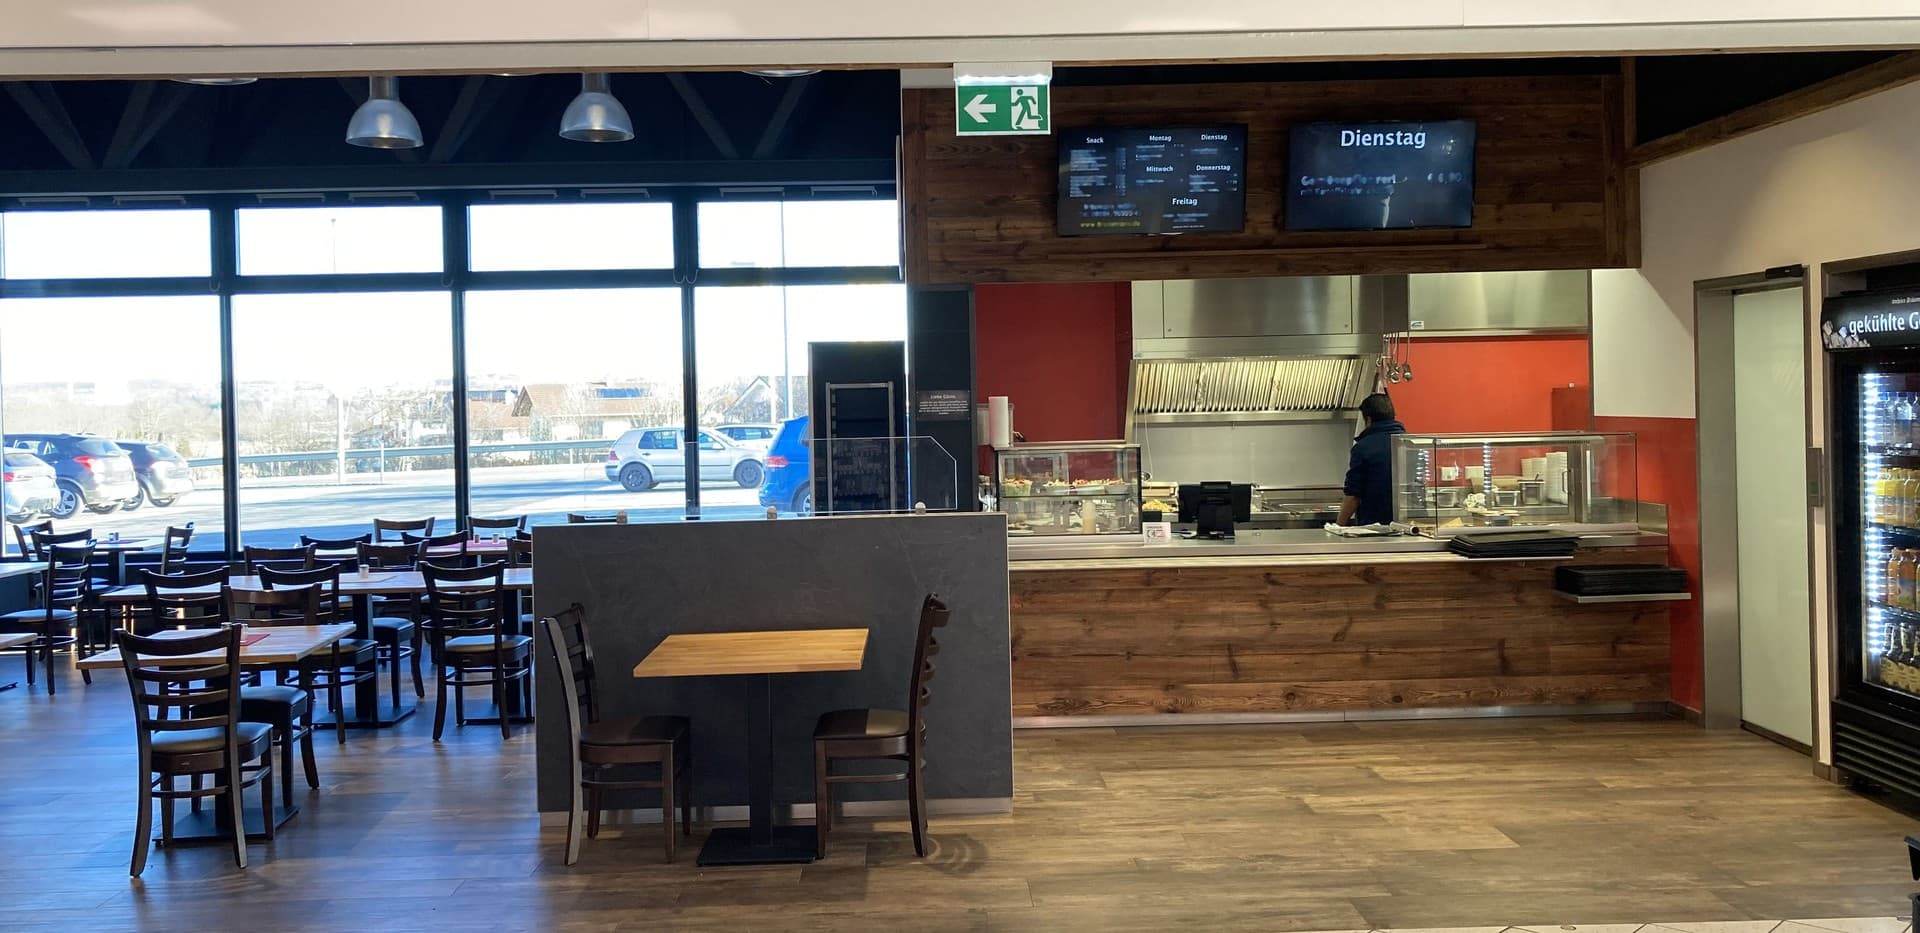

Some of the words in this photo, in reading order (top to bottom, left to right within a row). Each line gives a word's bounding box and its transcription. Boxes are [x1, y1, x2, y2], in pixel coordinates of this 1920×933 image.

[1341, 130, 1426, 148] Dienstag
[1172, 198, 1198, 206] Freitag
[1849, 313, 1905, 337] gekühlte
